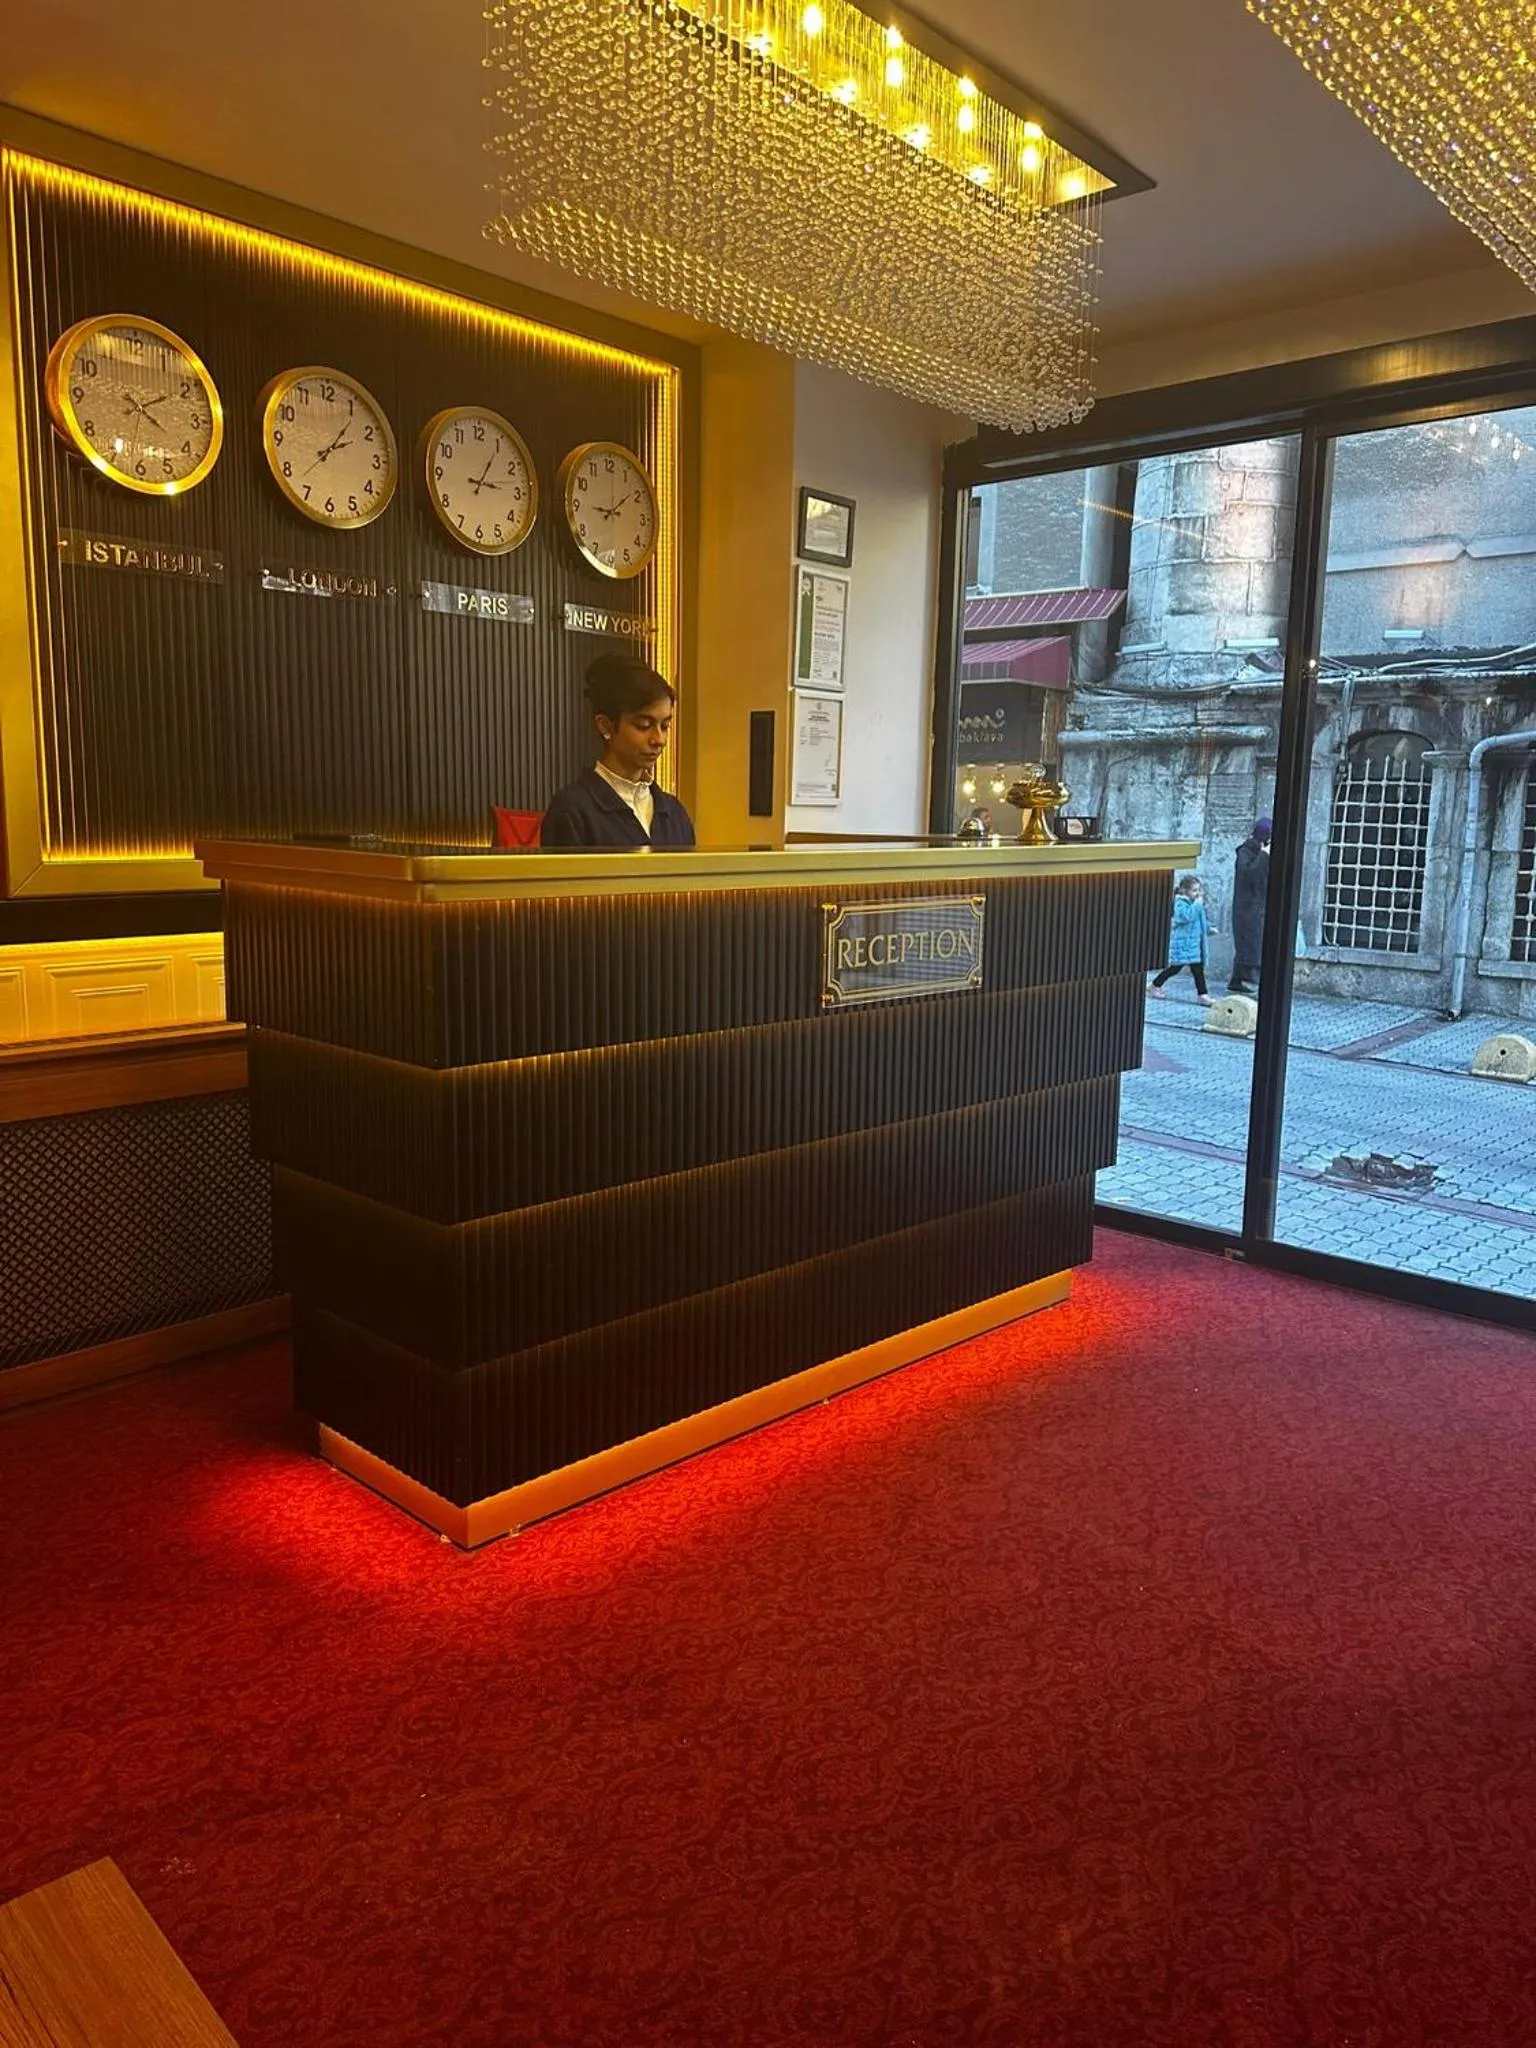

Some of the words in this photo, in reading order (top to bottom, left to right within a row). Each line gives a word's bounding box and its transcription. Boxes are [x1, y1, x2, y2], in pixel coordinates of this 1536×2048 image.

[127, 337, 143, 356] 12
[80, 358, 97, 378] 10
[161, 354, 166, 372] 1
[72, 387, 84, 404] 9
[180, 382, 190, 399] 2
[299, 387, 309, 405] 11
[321, 384, 335, 402] 12
[280, 404, 295, 422] 10
[348, 400, 353, 416] 1
[84, 420, 95, 437] 8
[191, 413, 200, 430] 3
[274, 430, 283, 446] 9
[364, 426, 373, 441] 2
[455, 428, 464, 445] 11
[472, 425, 485, 442] 12
[181, 440, 191, 456] 4
[441, 443, 453, 459] 10
[495, 438, 500, 453] 1
[135, 459, 146, 476] 6
[162, 458, 173, 474] 5
[283, 461, 292, 477] 8
[372, 454, 381, 469] 3
[508, 461, 516, 476] 2
[604, 459, 615, 473] 12
[435, 466, 444, 480] 9
[589, 462, 598, 477] 11
[364, 480, 373, 495] 4
[577, 477, 588, 492] 10
[303, 485, 311, 500] 7
[514, 486, 521, 501] 3
[634, 490, 641, 503] 2
[325, 497, 334, 512] 6
[348, 496, 357, 511] 5
[442, 493, 450, 508] 8
[573, 499, 581, 512] 9
[457, 514, 465, 528] 7
[507, 509, 515, 523] 4
[640, 514, 646, 526] 3
[475, 525, 484, 539] 6
[494, 524, 502, 538] 5
[580, 523, 586, 537] 8
[634, 535, 641, 547] 4
[592, 542, 599, 556] 7
[624, 549, 630, 562] 5
[85, 540, 210, 577] ISTANBUL
[288, 568, 377, 597] LONDON
[457, 592, 509, 615] PARIS
[573, 609, 608, 631] NEW
[837, 927, 975, 970] RECEPTION
